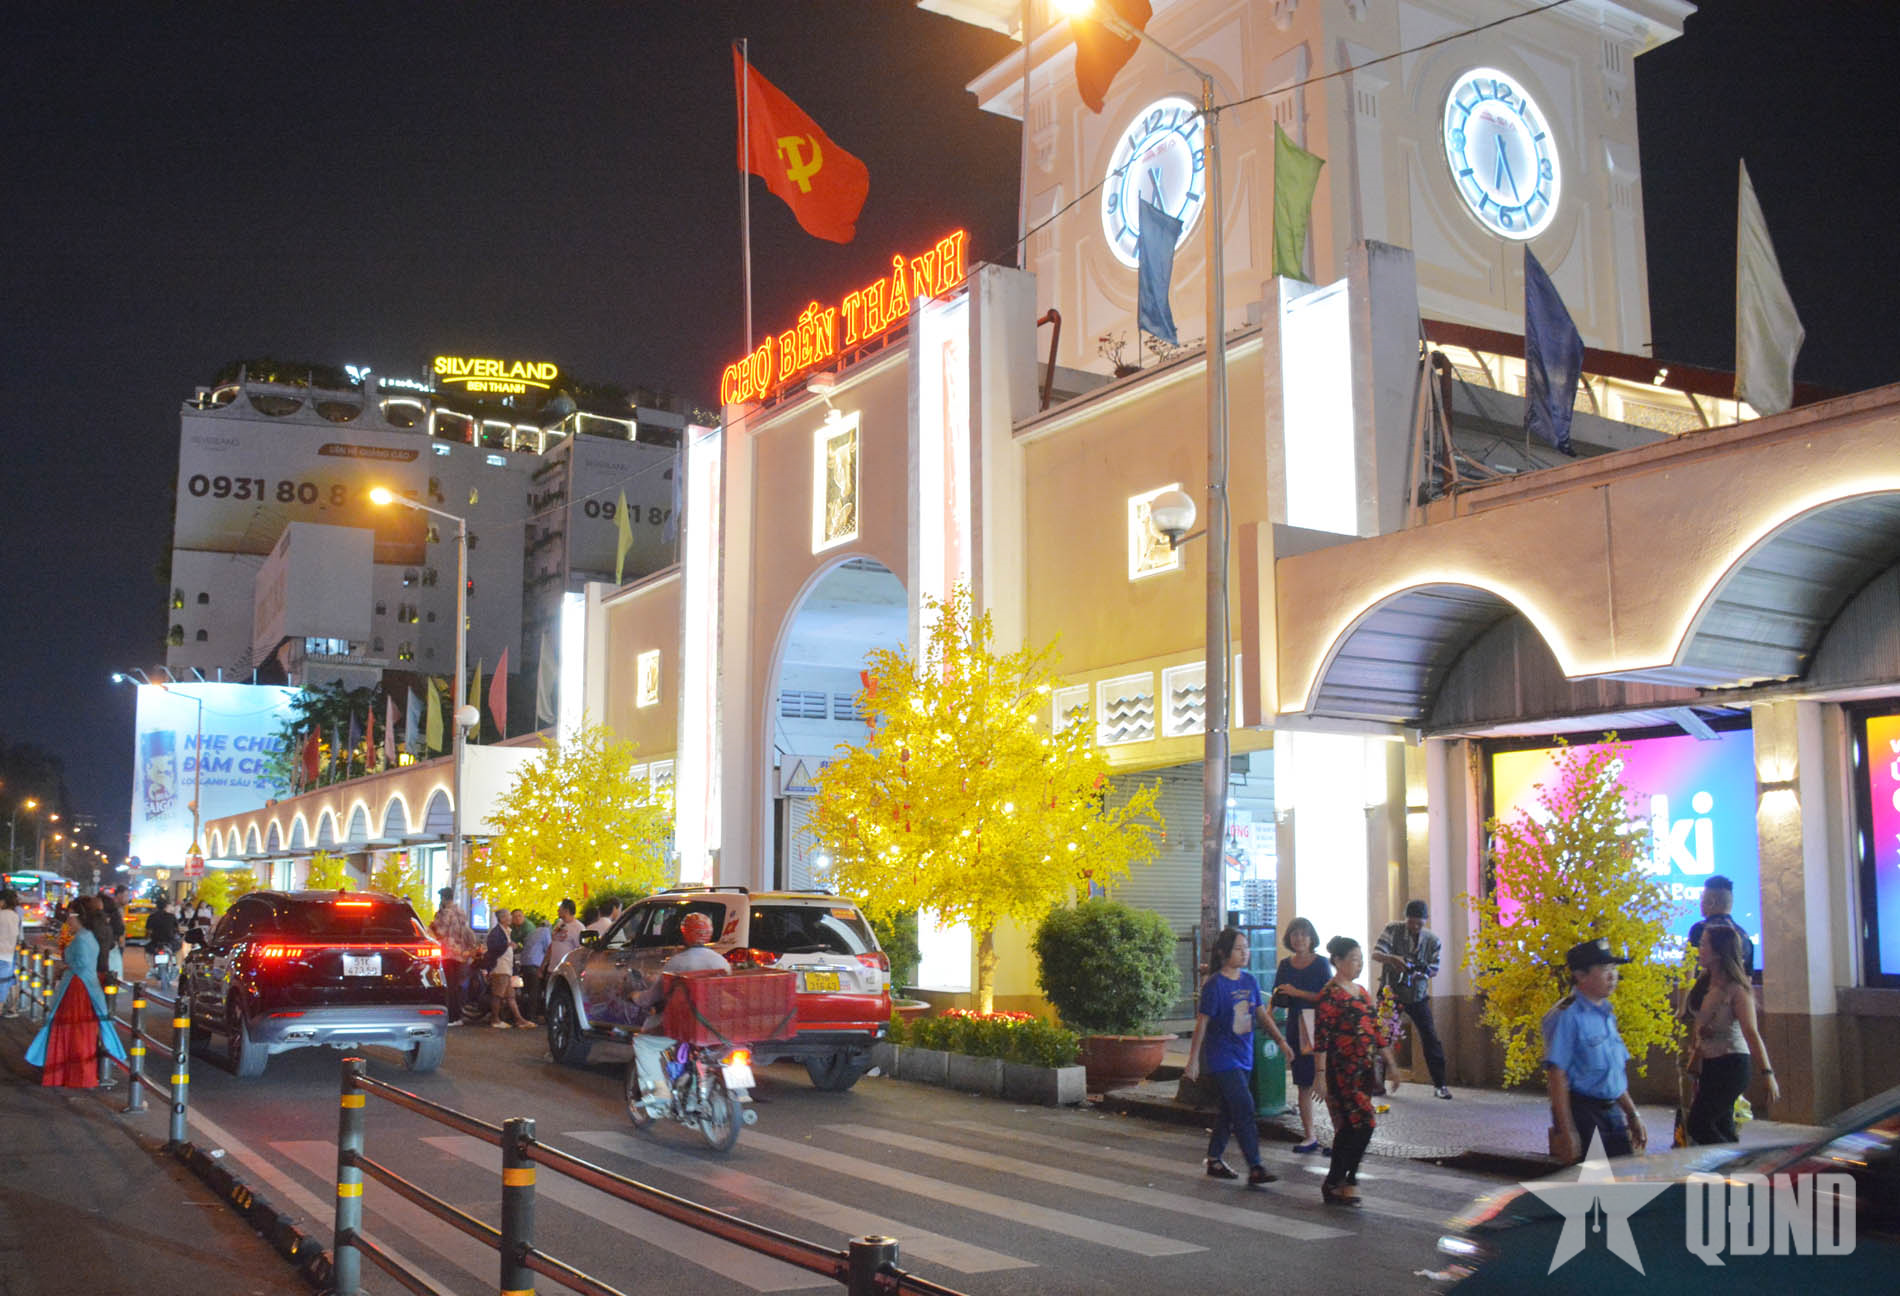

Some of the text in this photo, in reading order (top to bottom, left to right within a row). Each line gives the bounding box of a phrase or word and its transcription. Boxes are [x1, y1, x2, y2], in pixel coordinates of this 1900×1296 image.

[1491, 80, 1514, 105] 12
[1143, 109, 1165, 136] 12
[1541, 158, 1553, 180] 3
[1107, 193, 1119, 215] 9
[721, 230, 964, 406] CHỢ BẾN THÀNH
[434, 356, 558, 380] SILVERLAND
[467, 381, 526, 394] BEN THANH
[188, 474, 265, 501] 0931
[276, 480, 318, 504] 80
[584, 500, 641, 523] 091
[184, 734, 287, 755] NHẸ CHIL
